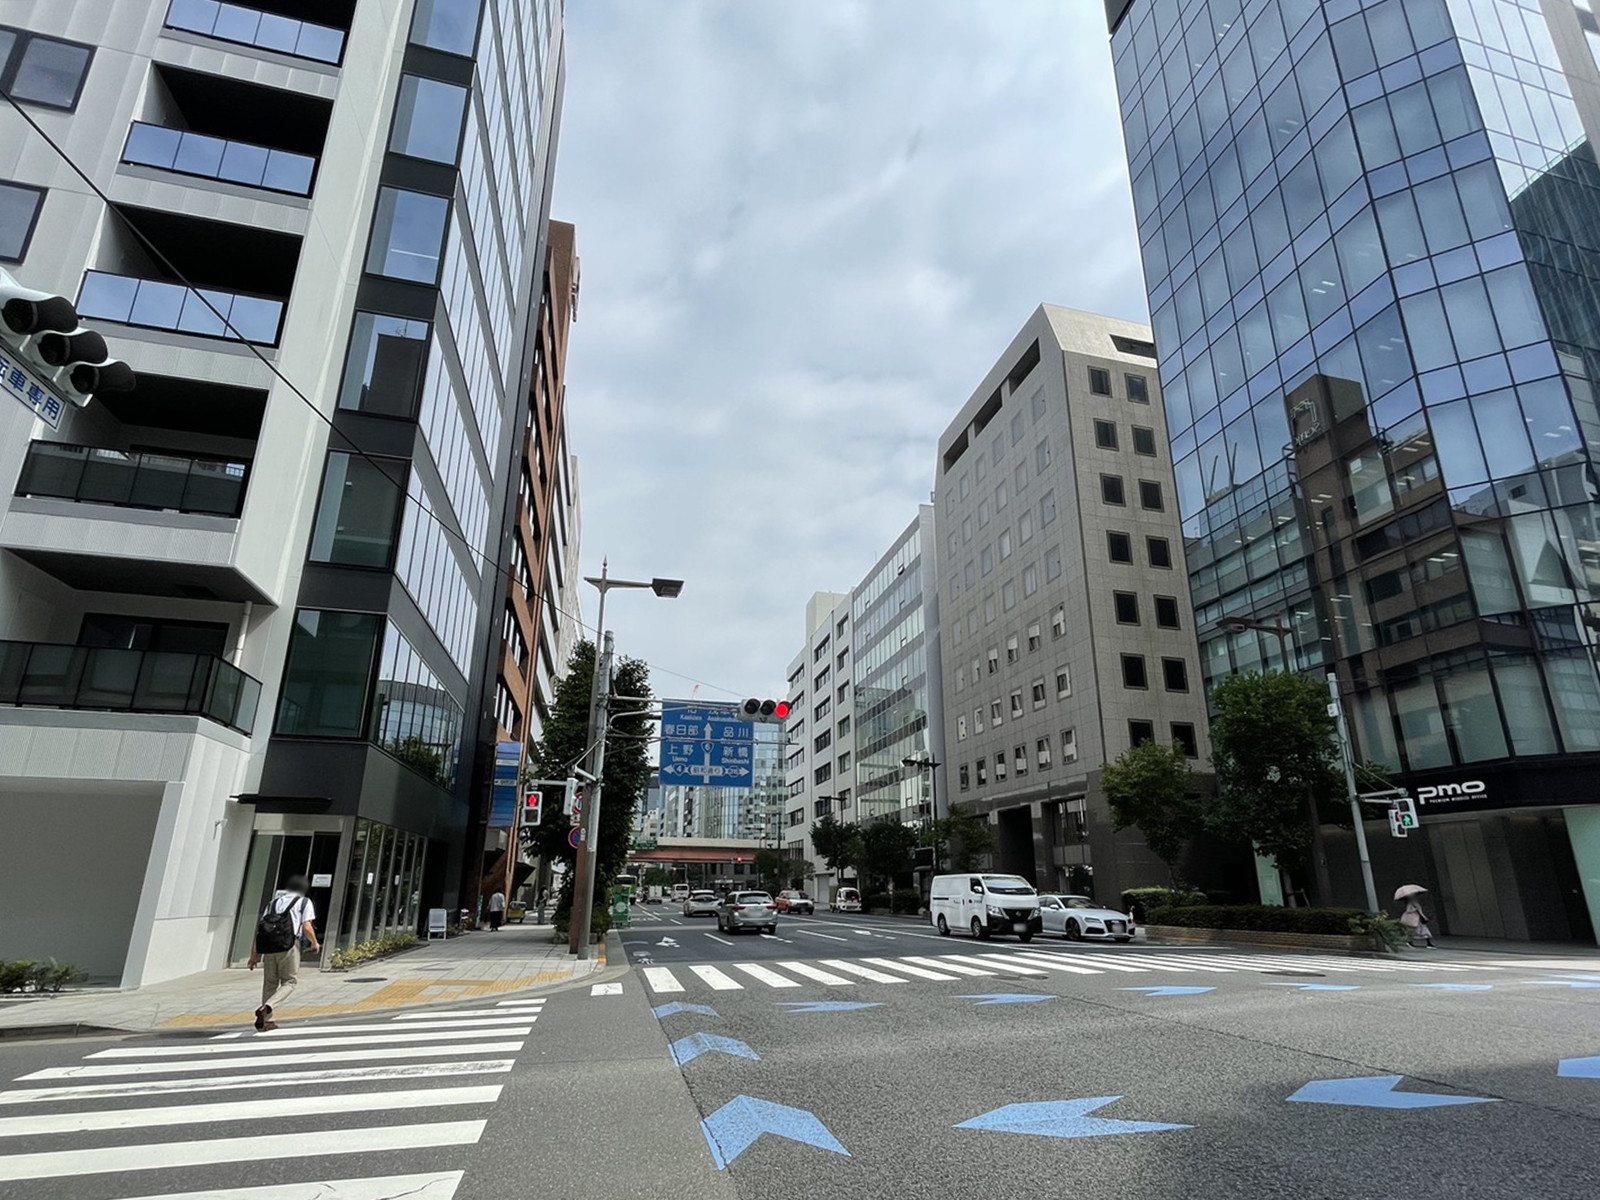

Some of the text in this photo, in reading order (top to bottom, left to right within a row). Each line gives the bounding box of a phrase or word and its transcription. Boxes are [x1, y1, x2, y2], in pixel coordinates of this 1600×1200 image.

[664, 724, 699, 736] 春日部
[723, 726, 749, 738] 品川
[667, 744, 694, 756] 上野
[723, 746, 748, 758] 新橋
